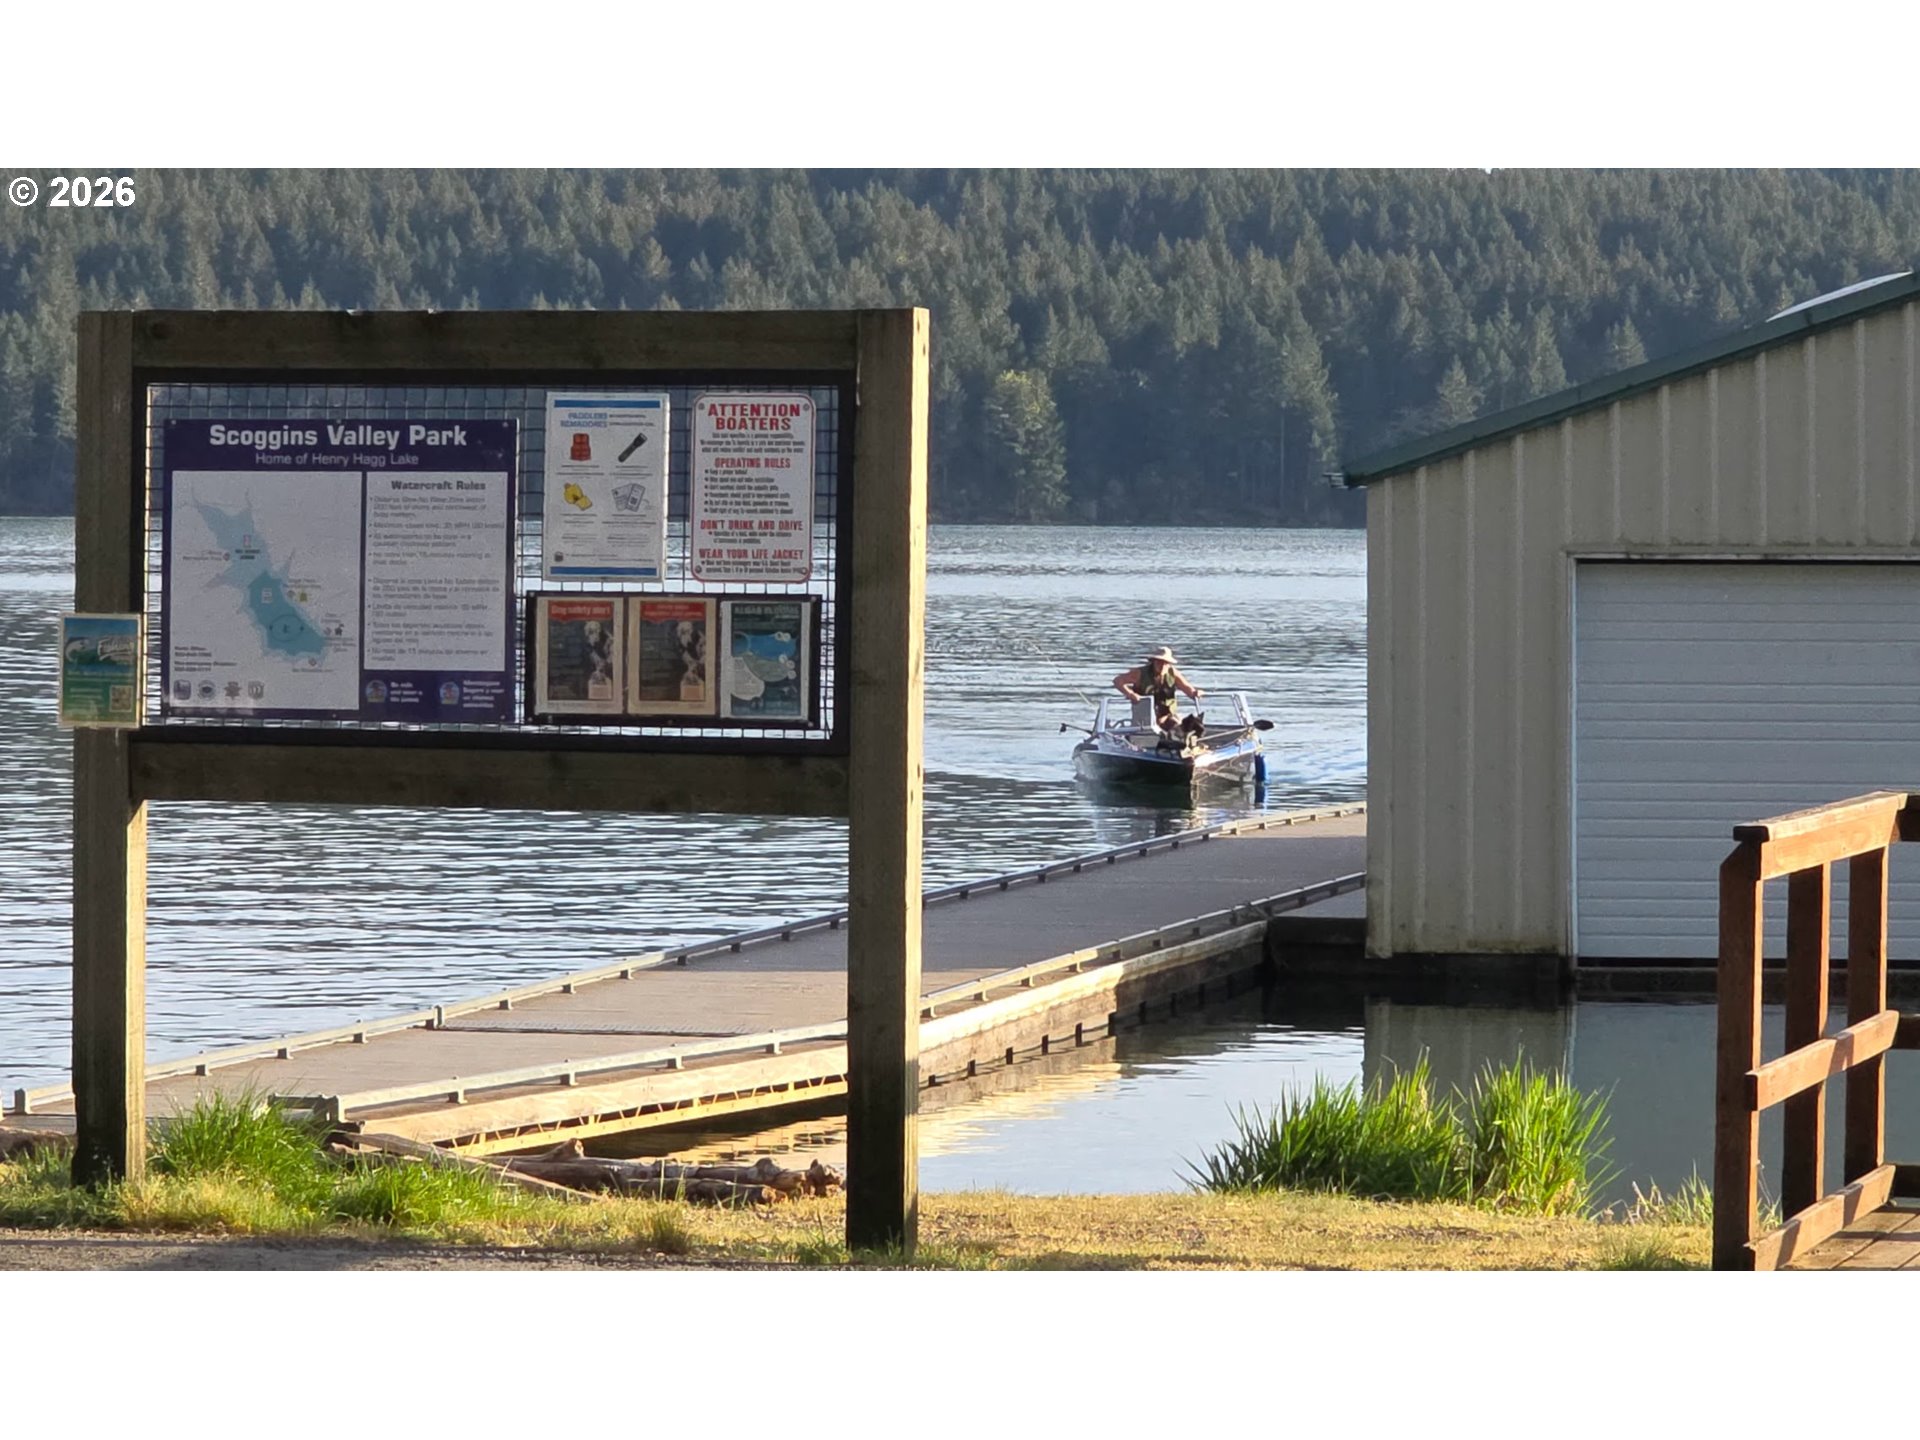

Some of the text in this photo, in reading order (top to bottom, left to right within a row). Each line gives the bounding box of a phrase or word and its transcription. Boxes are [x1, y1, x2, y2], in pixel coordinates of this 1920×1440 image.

[707, 403, 801, 417] ATTENTION
[715, 417, 791, 431] BOATERS
[209, 424, 467, 451] Scoggins Valley Park
[255, 452, 419, 467] Home of Henry Hagg Lake
[714, 457, 791, 469] OPERATING RULES
[391, 480, 486, 491] Watercraft Rules
[700, 520, 803, 531] DON'T DRINK AND DRIVE
[699, 548, 804, 560] WEAR YOUR LIFE JACKET
